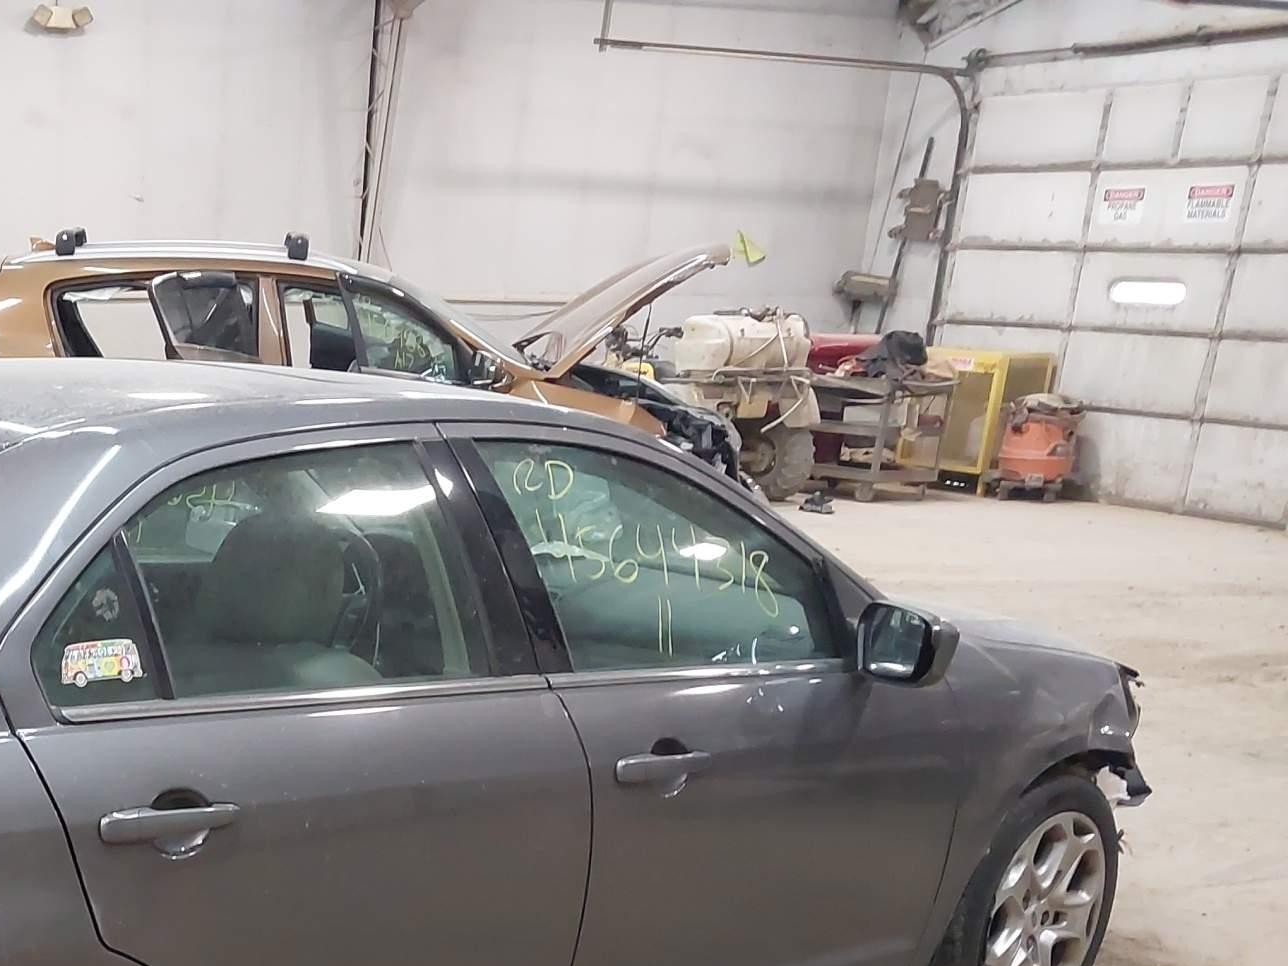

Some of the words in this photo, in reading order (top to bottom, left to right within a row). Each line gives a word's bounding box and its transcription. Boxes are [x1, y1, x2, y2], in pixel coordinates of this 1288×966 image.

[1186, 198, 1230, 208] FLAMMABLE
[1186, 208, 1226, 219] MATERIALS
[513, 458, 574, 500] RD
[530, 508, 779, 618] 45644318
